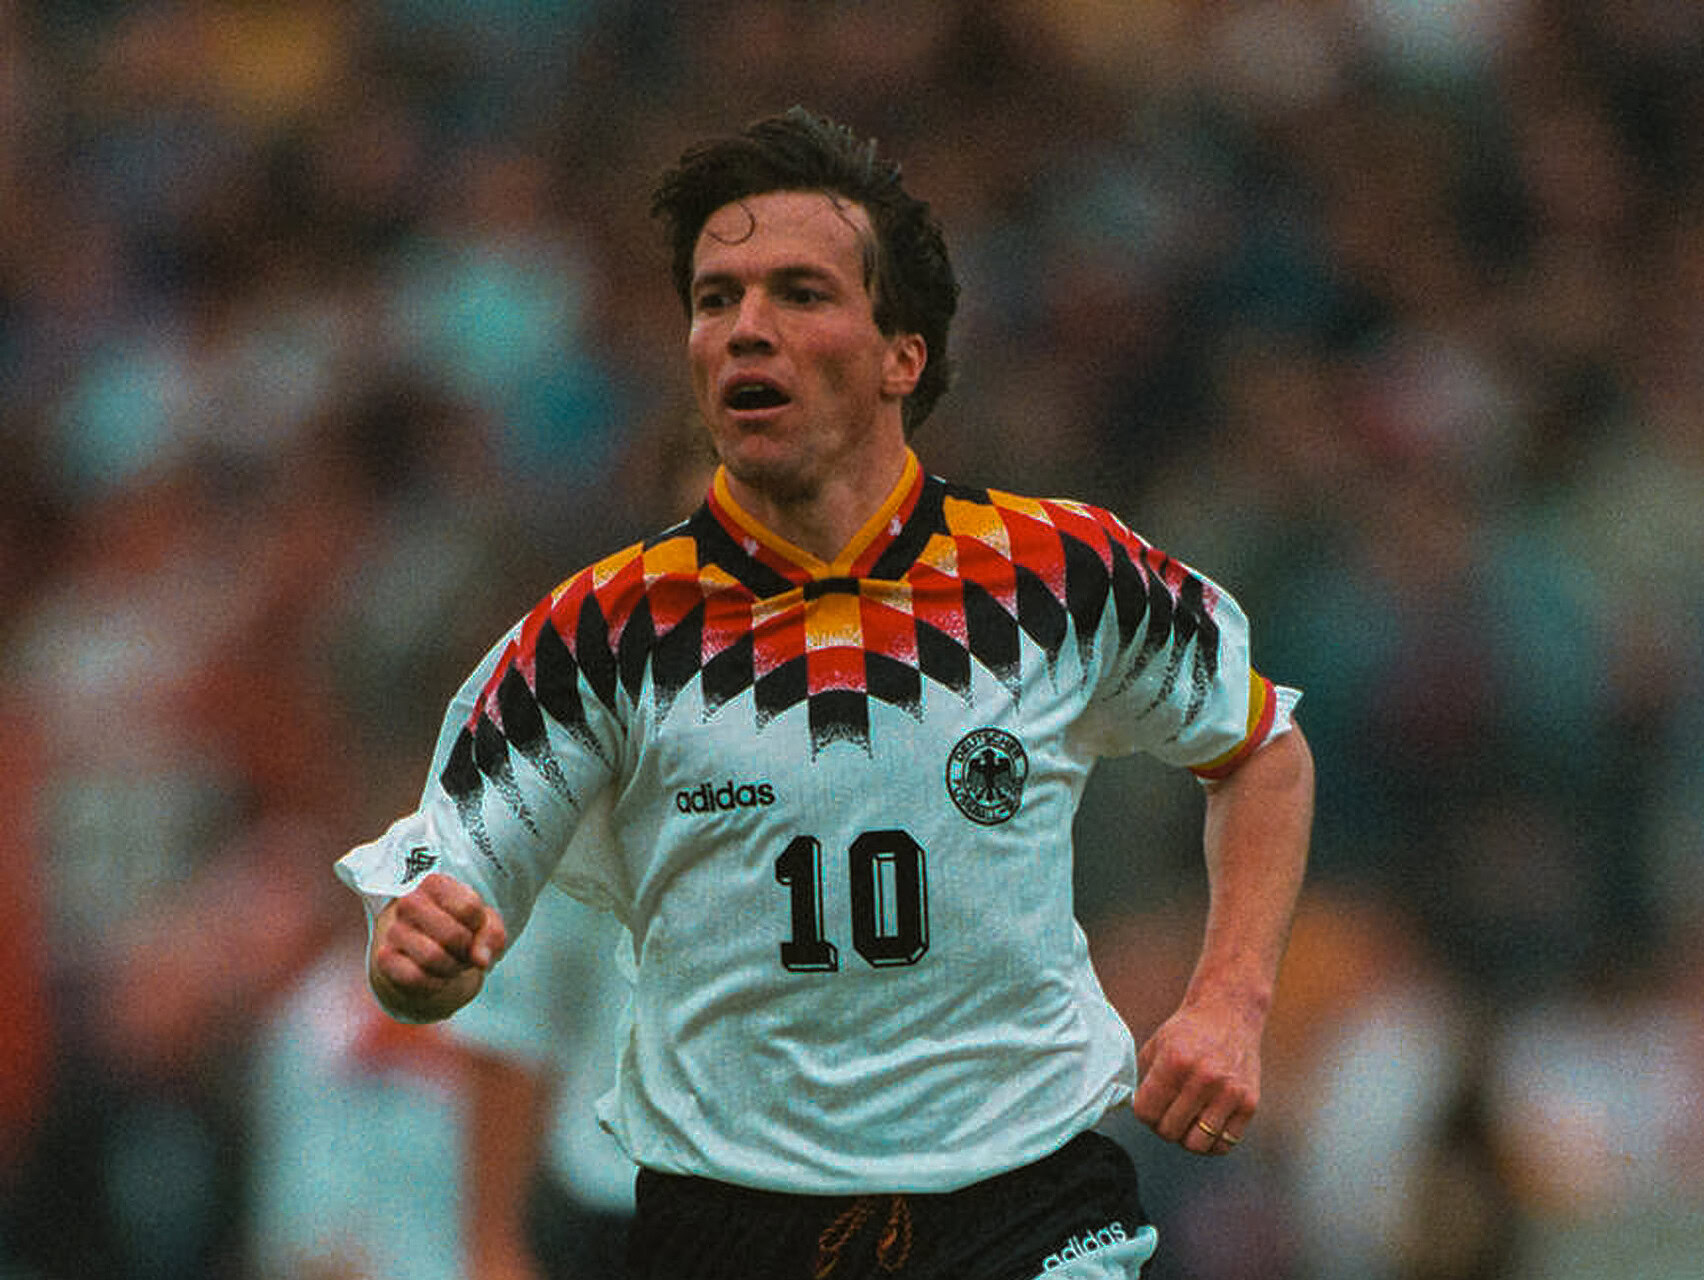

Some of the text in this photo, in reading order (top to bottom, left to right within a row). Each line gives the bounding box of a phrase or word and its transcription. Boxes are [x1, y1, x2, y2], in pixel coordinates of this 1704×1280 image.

[677, 780, 776, 814] adidas
[775, 829, 929, 972] 10
[1042, 1221, 1127, 1272] adidas
